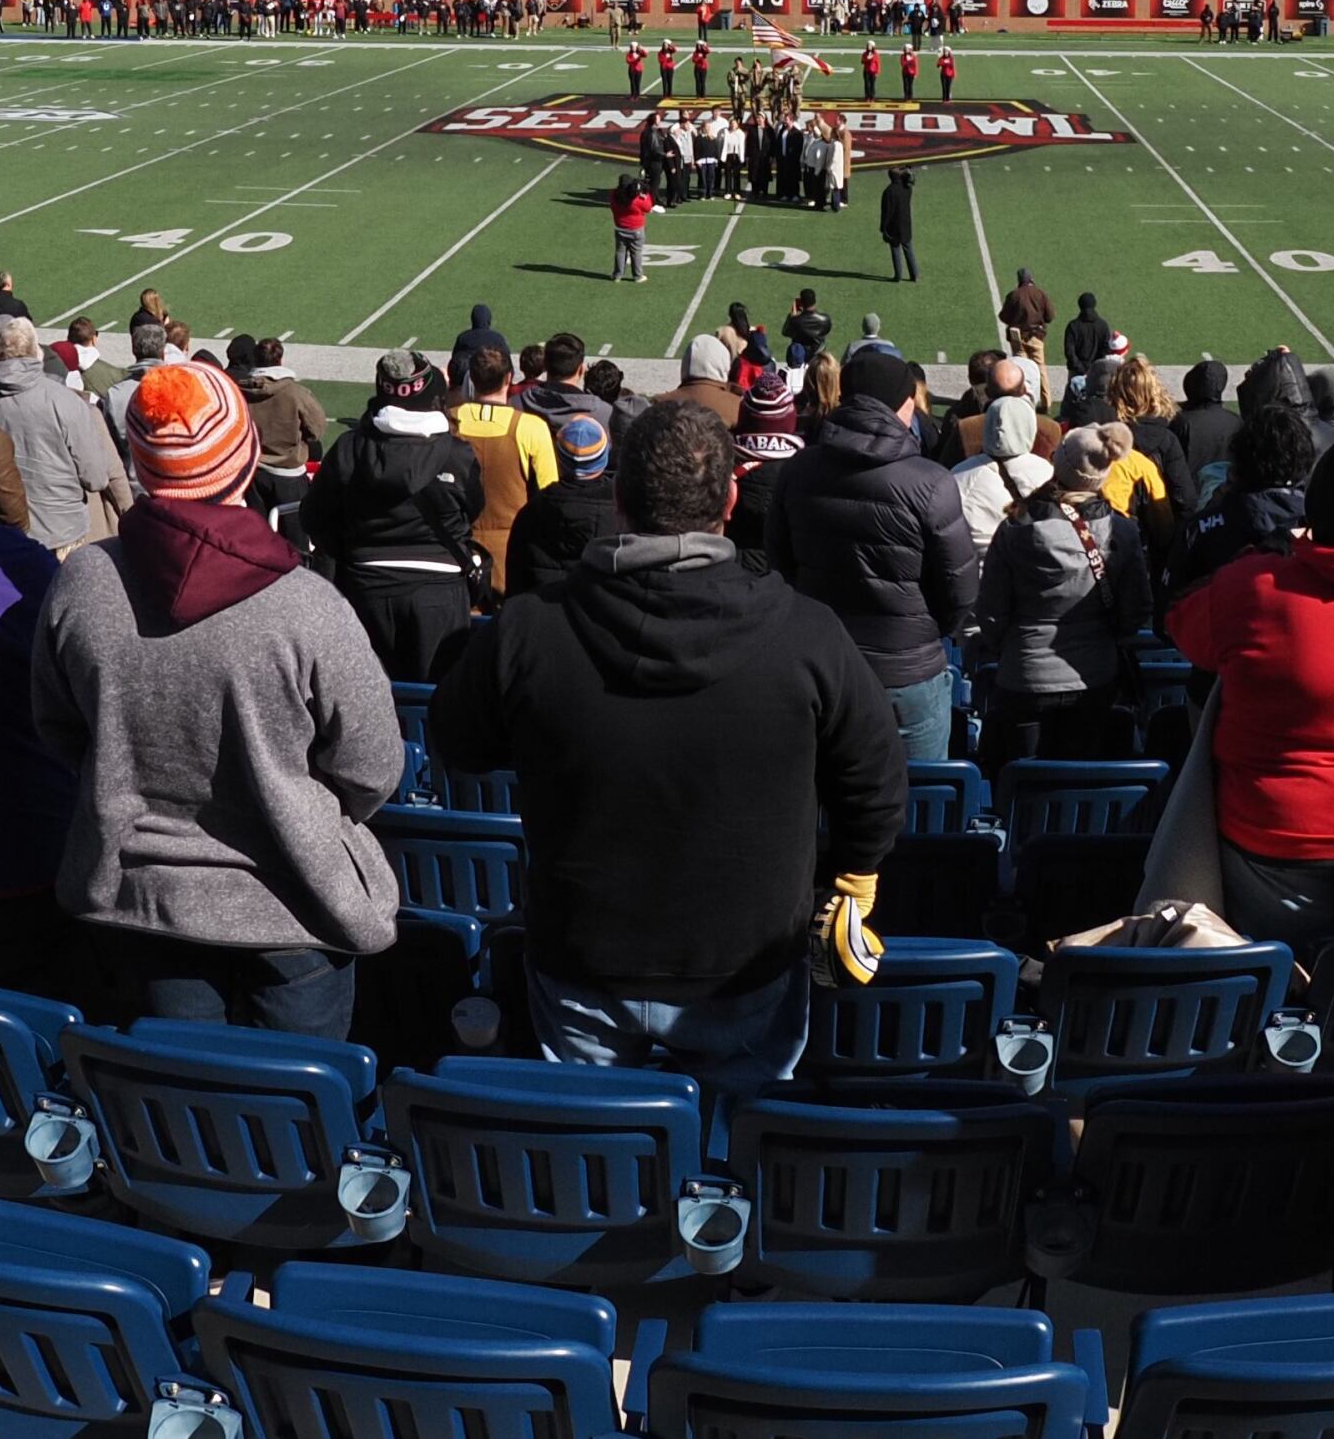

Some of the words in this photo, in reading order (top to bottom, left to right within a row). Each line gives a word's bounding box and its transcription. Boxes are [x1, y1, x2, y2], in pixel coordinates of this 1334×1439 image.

[1101, 0, 1129, 9] ZEBRA
[1298, 0, 1316, 10] spire
[459, 105, 732, 131] SEN
[841, 111, 1112, 140] BOWL
[117, 228, 294, 252] 40
[629, 244, 811, 267] 50
[379, 377, 425, 397] 908
